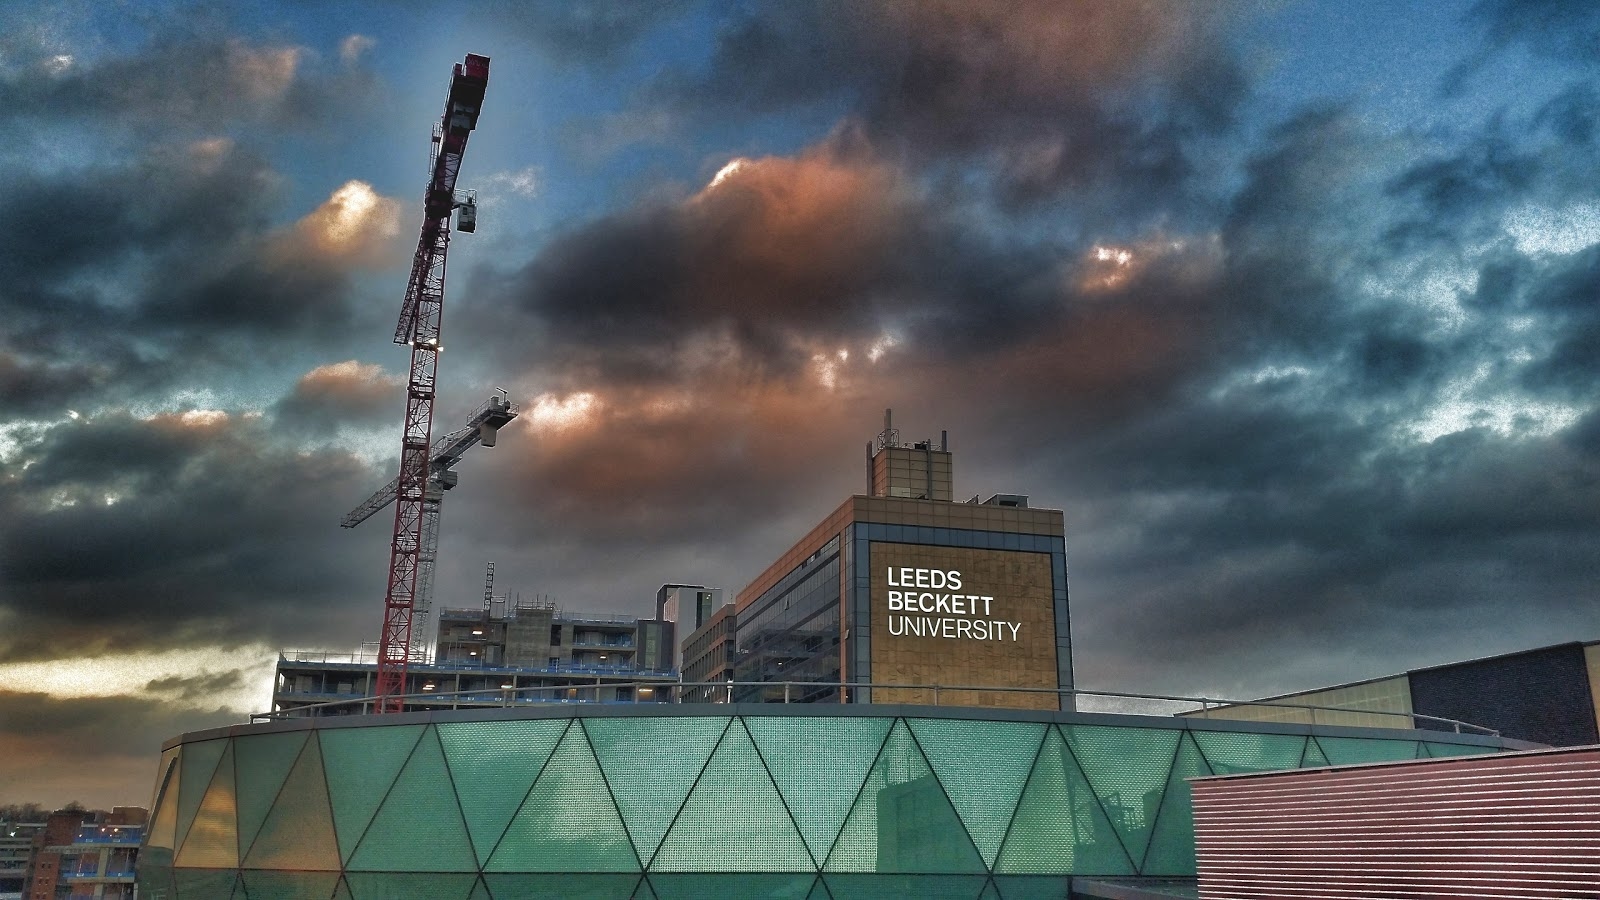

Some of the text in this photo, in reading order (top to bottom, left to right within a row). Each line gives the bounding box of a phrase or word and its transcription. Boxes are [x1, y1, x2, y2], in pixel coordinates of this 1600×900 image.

[887, 566, 962, 590] LEEDS
[888, 590, 994, 616] BECKETT
[888, 615, 1022, 642] UNIVERSITY
